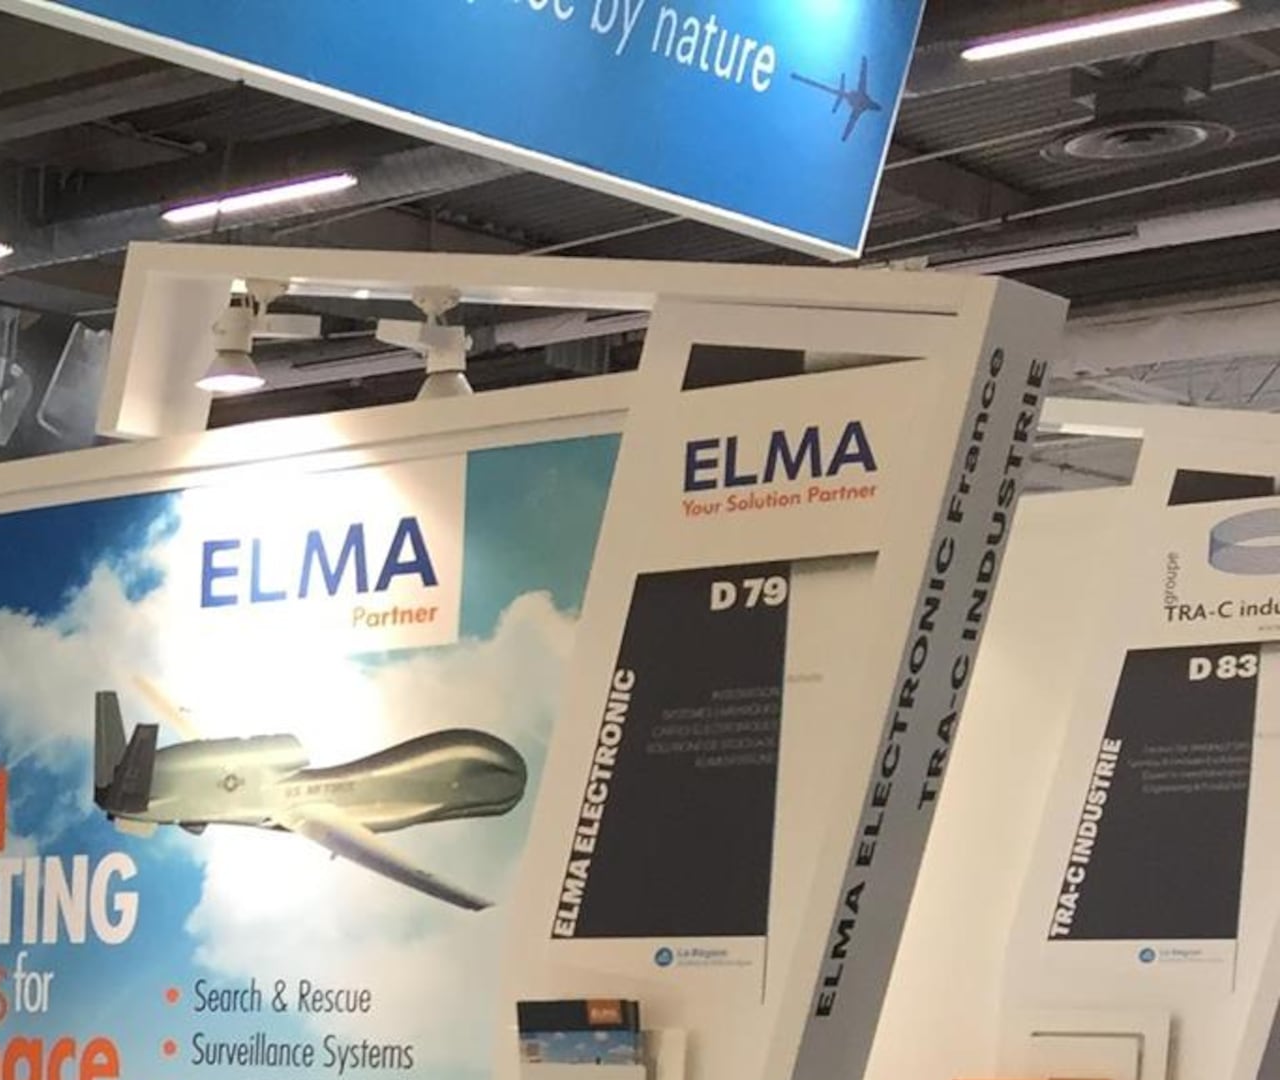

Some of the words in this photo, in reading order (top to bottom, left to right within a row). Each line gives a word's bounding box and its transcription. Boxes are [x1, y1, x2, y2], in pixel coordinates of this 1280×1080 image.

[651, 9, 777, 93] nature
[683, 420, 878, 493] ELMA
[682, 500, 722, 518] Your
[726, 490, 801, 513] Solution
[807, 484, 878, 503] Partner
[200, 516, 439, 609] ELMA
[917, 654, 971, 811] TRA-C
[960, 358, 1048, 641] INDUSTRIE
[352, 604, 439, 628] Partner
[711, 581, 738, 611] D
[745, 577, 790, 607] 79
[1164, 600, 1233, 622] TRA-C
[814, 881, 866, 1017] ELMA
[854, 536, 955, 867] ELECTRONIC
[946, 347, 1005, 523] France
[1189, 656, 1211, 681] D
[1216, 654, 1259, 679] 83
[553, 857, 591, 939] ELMA
[575, 667, 637, 855] ELECTRONIC
[1050, 864, 1086, 938] TRA-C
[1072, 736, 1124, 864] INDUSTRIE
[13, 951, 53, 1013] for
[193, 978, 262, 1013] Search
[271, 979, 288, 1013] &
[297, 979, 372, 1014] Rescue
[191, 1032, 315, 1067] Surveillance
[323, 1034, 415, 1075] Systems
